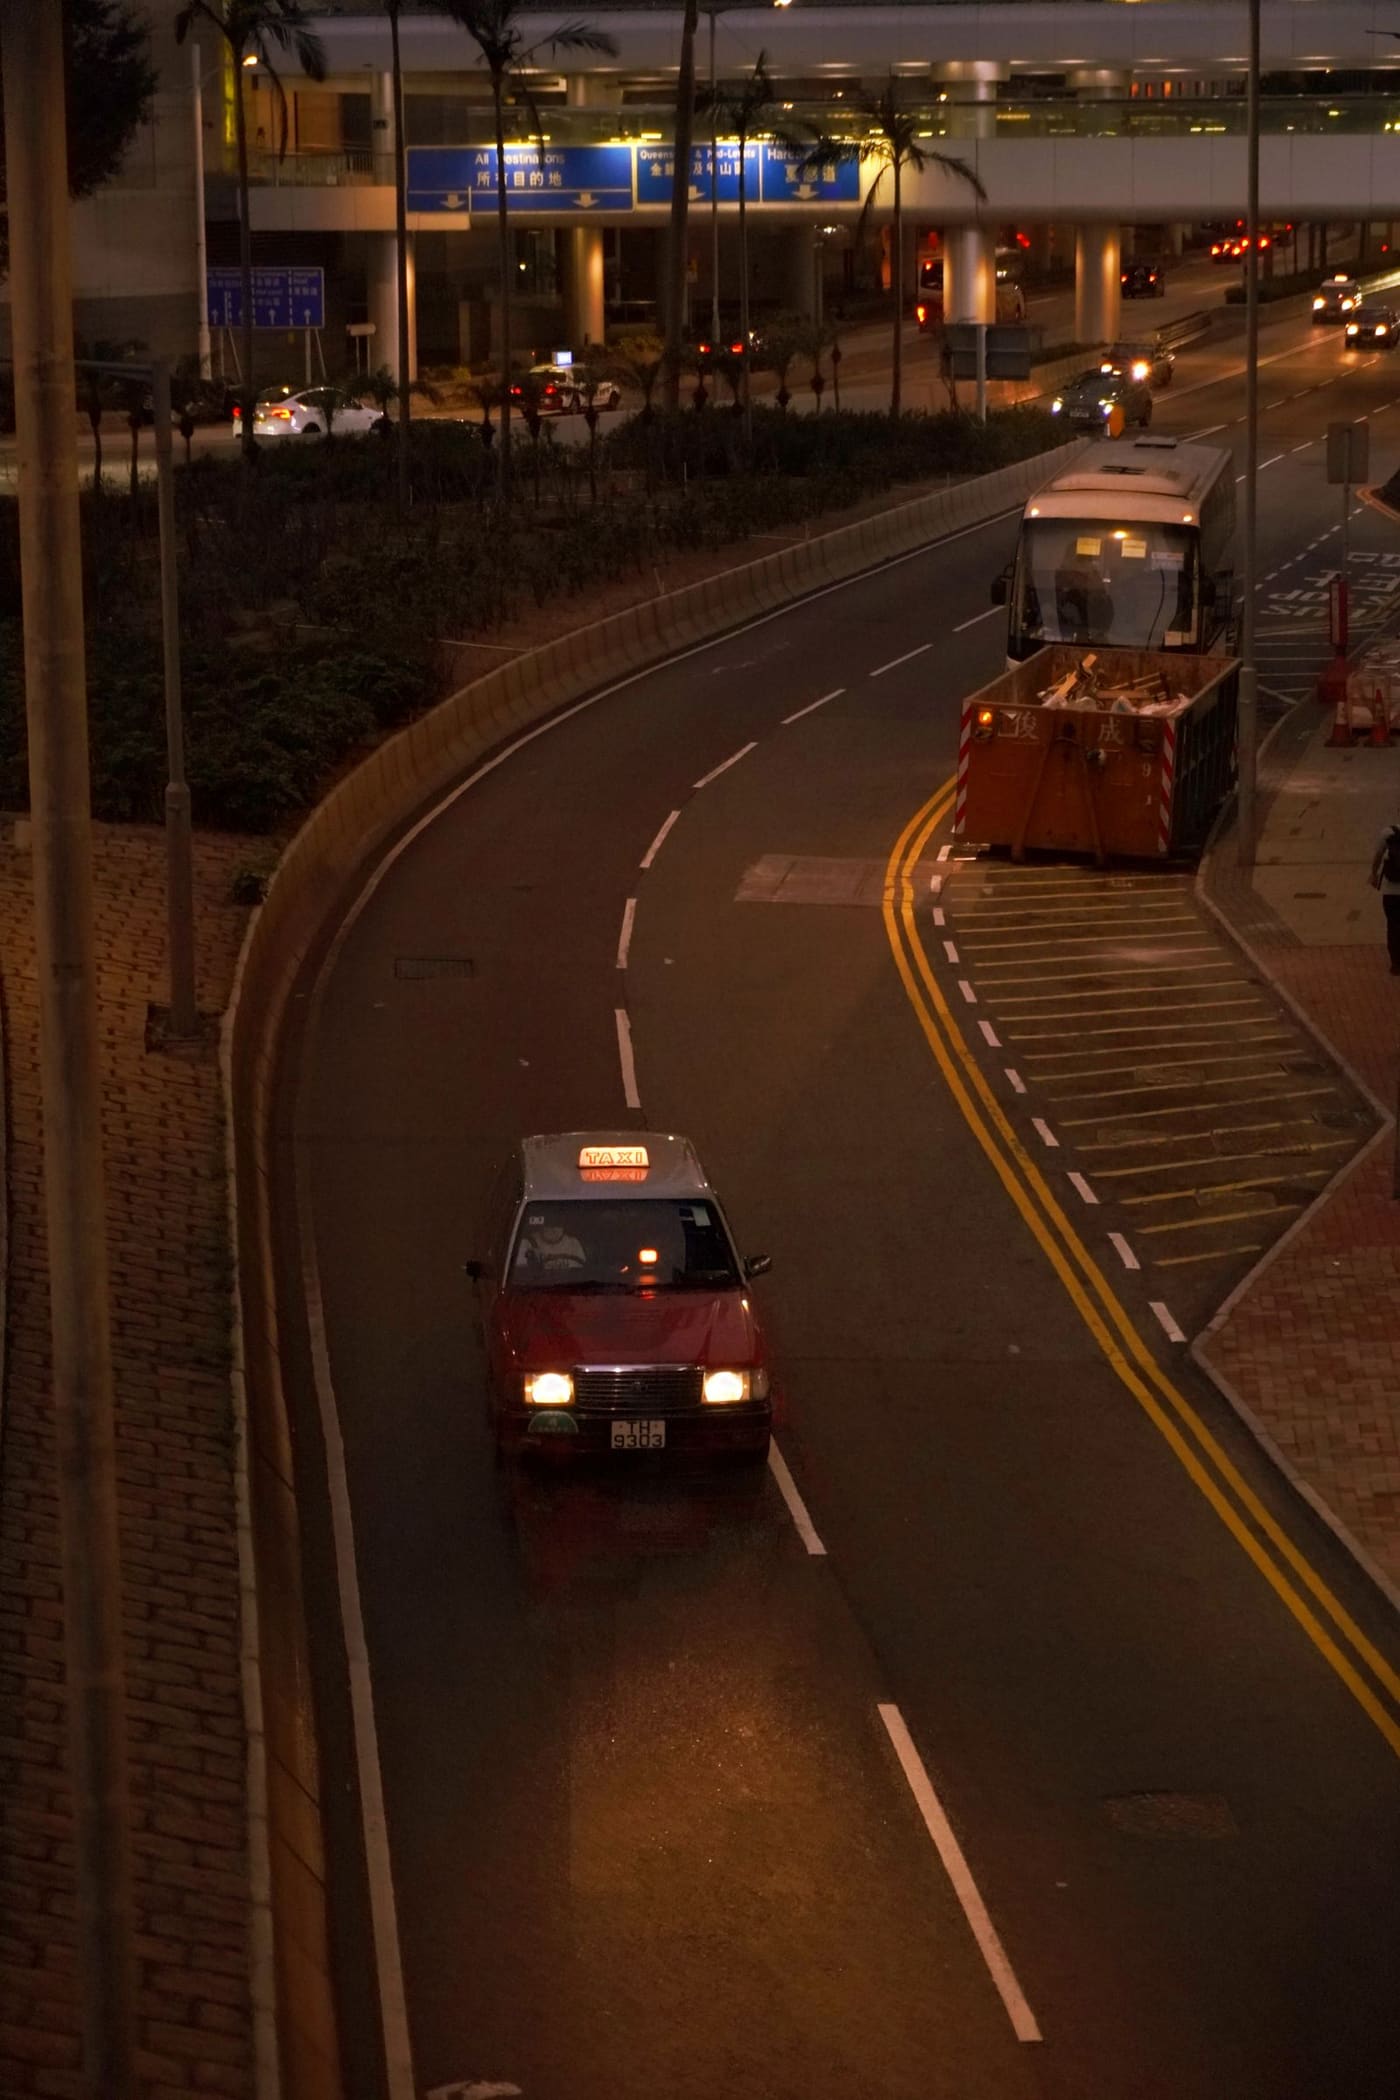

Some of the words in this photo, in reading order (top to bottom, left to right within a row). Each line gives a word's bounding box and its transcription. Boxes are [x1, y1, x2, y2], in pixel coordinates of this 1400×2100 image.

[475, 153, 489, 165] All
[585, 1152, 643, 1164] TAXI
[626, 1420, 650, 1434] TH
[614, 1434, 662, 1448] 9303
